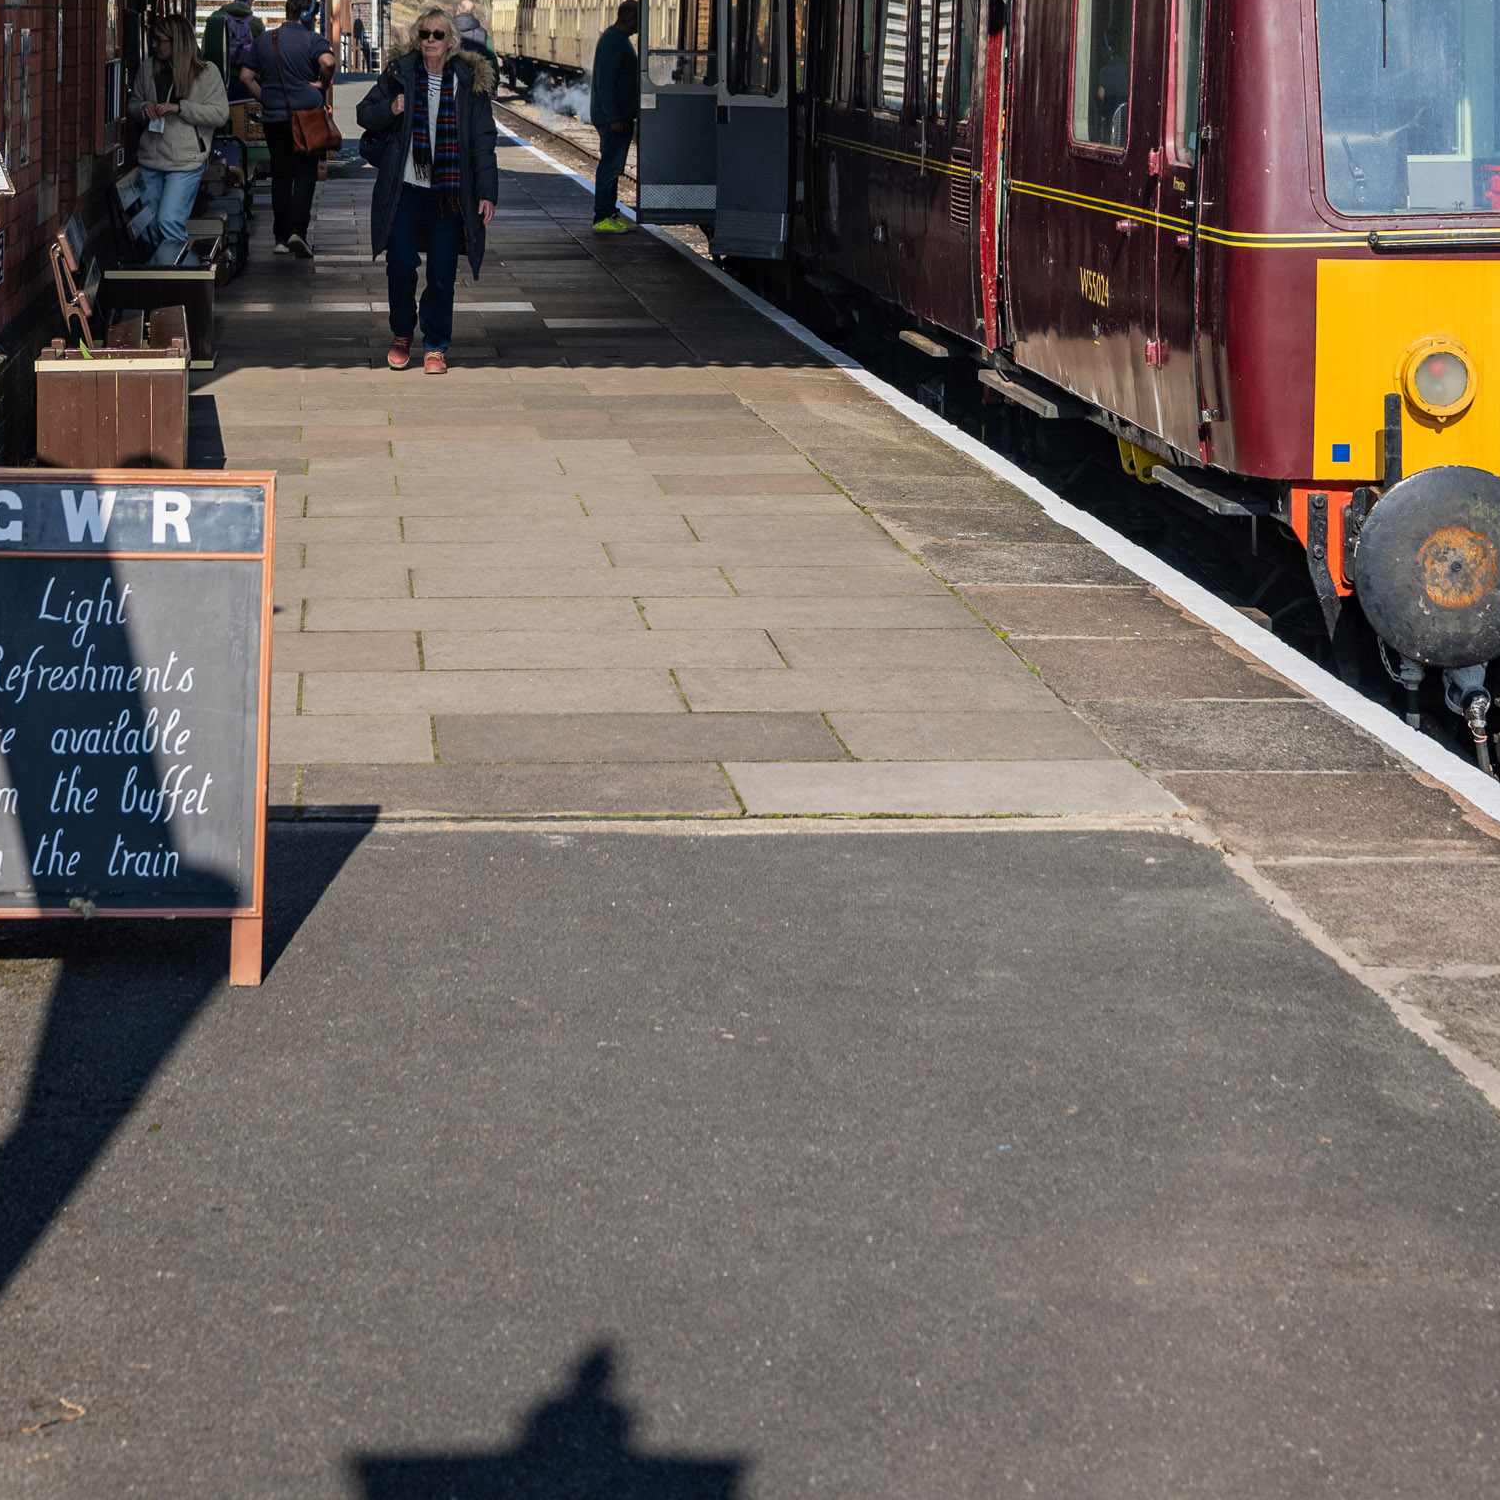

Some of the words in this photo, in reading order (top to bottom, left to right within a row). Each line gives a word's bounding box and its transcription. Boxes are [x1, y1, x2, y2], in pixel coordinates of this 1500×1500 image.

[1079, 266, 1110, 308] W55024
[38, 576, 133, 648] Light
[50, 707, 191, 756] available
[49, 765, 99, 815] the
[120, 764, 213, 824] buffet
[31, 828, 82, 878] the
[107, 833, 179, 878] train
